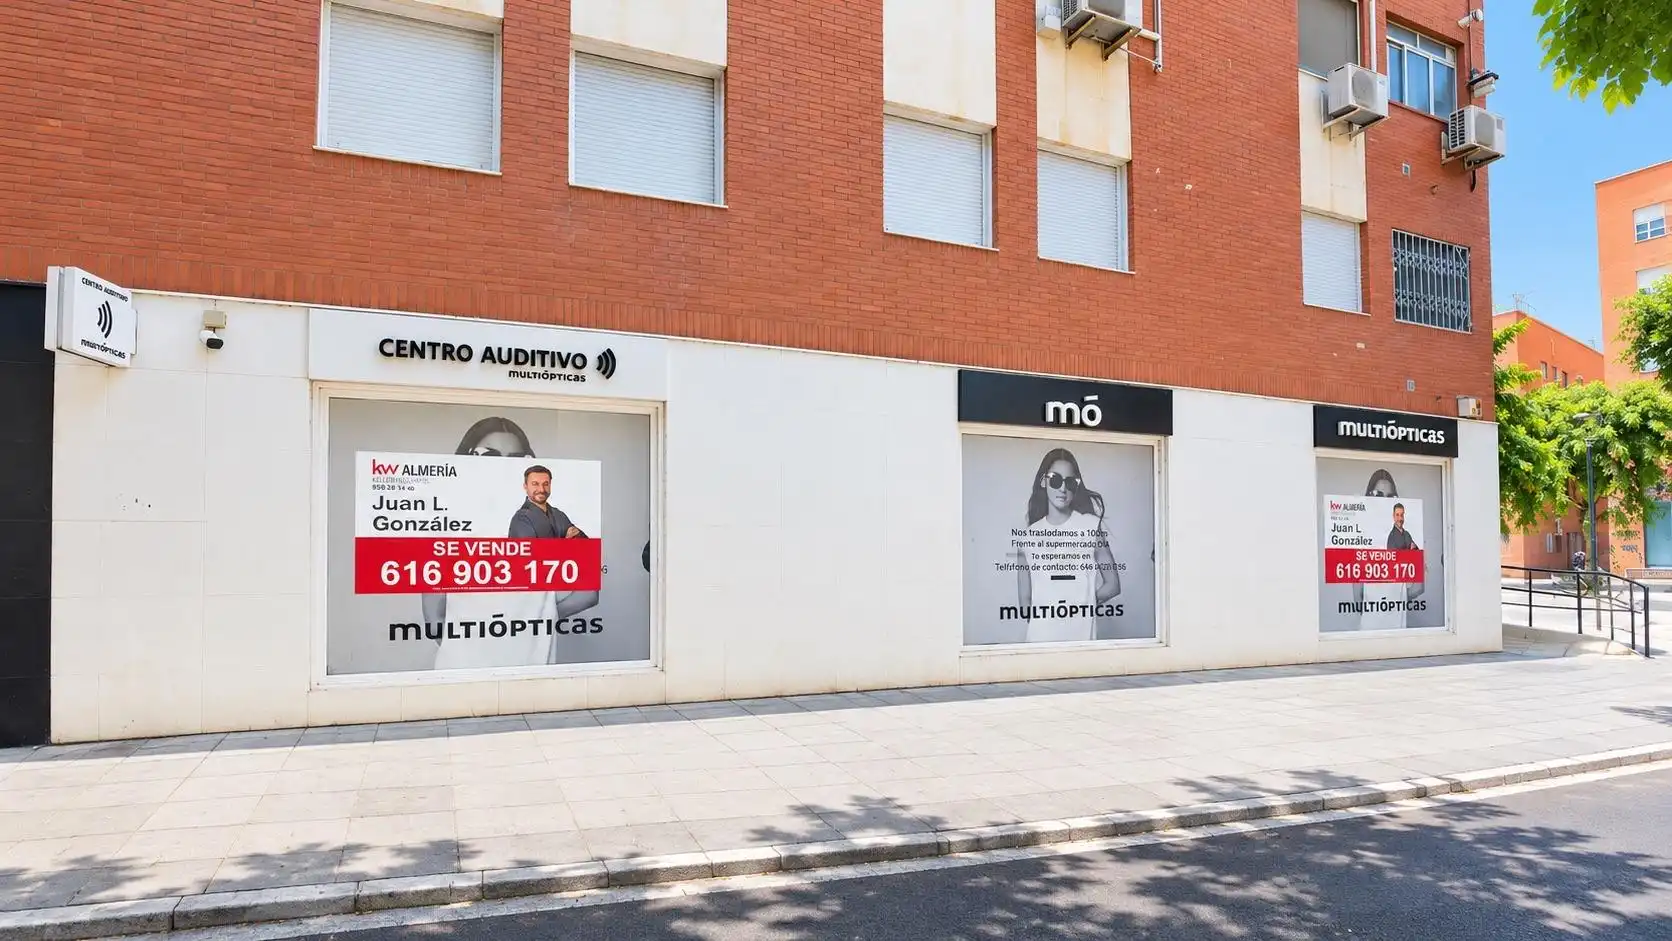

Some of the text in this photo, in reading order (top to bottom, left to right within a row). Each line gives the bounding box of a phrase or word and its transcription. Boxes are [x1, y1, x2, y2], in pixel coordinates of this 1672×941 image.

[378, 338, 588, 370] CENTRO AUDITIVO
[372, 459, 457, 477] kw ALMERÍA
[372, 495, 426, 511] Juan
[372, 515, 472, 532] González
[1331, 523, 1354, 533] Juan
[1011, 528, 1027, 537] Nos
[1331, 534, 1373, 546] González
[433, 541, 532, 556] SE VENDE
[1356, 551, 1396, 561] SE VENDE
[380, 560, 442, 586] 616
[452, 560, 512, 585] 903
[524, 559, 579, 584] 170
[1031, 563, 1041, 571] de
[1336, 563, 1415, 579] 616 903 170
